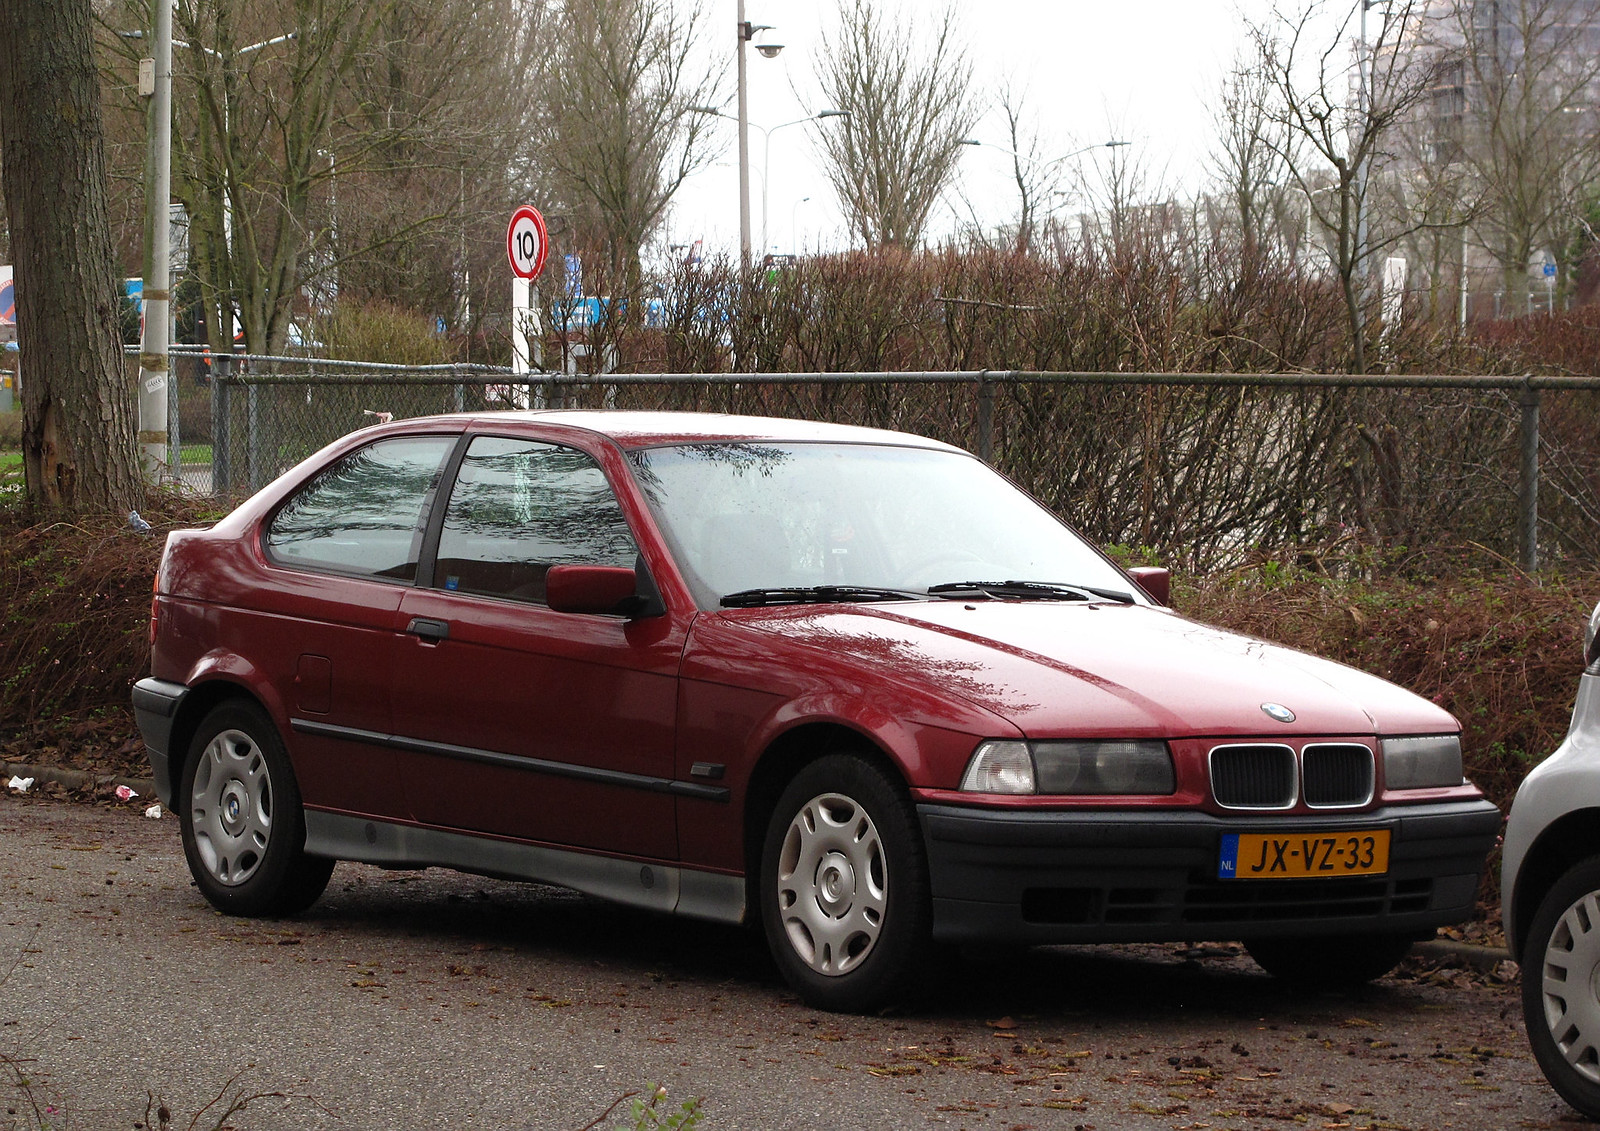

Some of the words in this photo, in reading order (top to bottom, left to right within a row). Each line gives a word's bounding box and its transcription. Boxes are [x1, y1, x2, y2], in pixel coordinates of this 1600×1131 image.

[517, 231, 534, 260] 10
[1221, 860, 1234, 871] NL
[1252, 837, 1375, 872] JX-VZ-33
